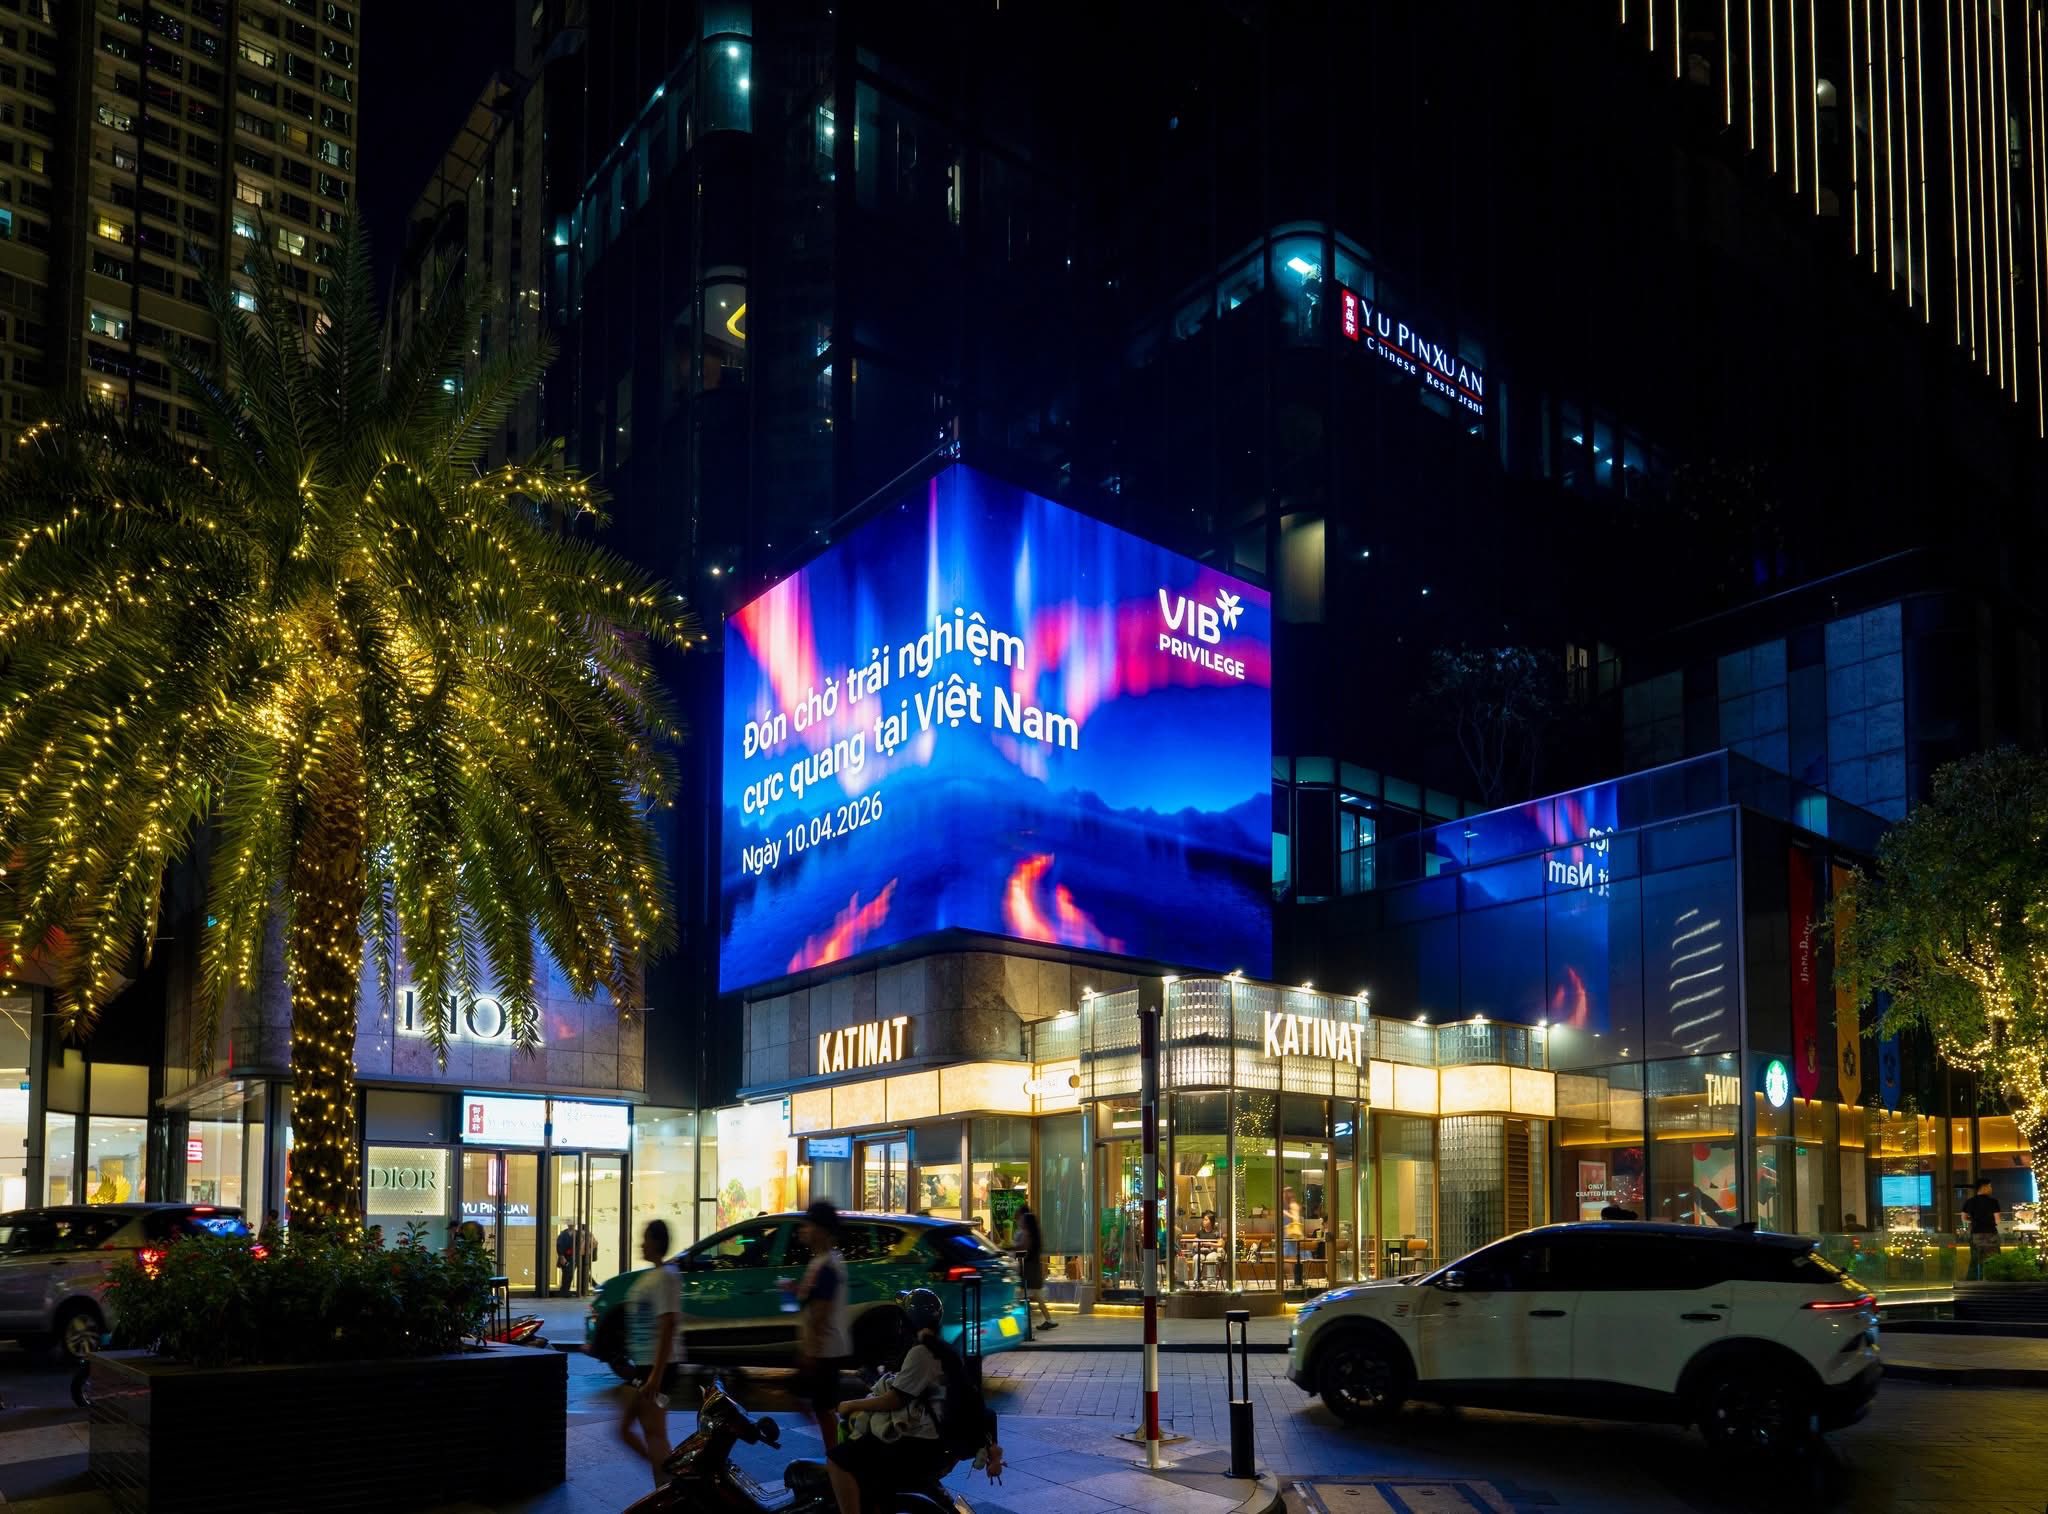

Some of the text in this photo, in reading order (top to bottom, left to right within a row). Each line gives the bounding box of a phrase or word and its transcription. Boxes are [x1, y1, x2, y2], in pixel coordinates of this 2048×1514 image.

[1361, 299, 1483, 396] YU PINXUAN
[1367, 337, 1416, 375] Chinese
[1159, 588, 1221, 645] VIB
[743, 606, 1025, 760] Đón chờ trải nghiệm
[1159, 633, 1246, 680] PRIVILEGE
[743, 672, 1079, 816] cực quang tại Việt Nam
[742, 790, 883, 876] Ngày 10.04.2026
[818, 1016, 908, 1075] KATINAT
[1264, 1010, 1365, 1068] KATINAT
[369, 1167, 438, 1191] DIOR
[461, 1202, 529, 1214] YU PINUAN
